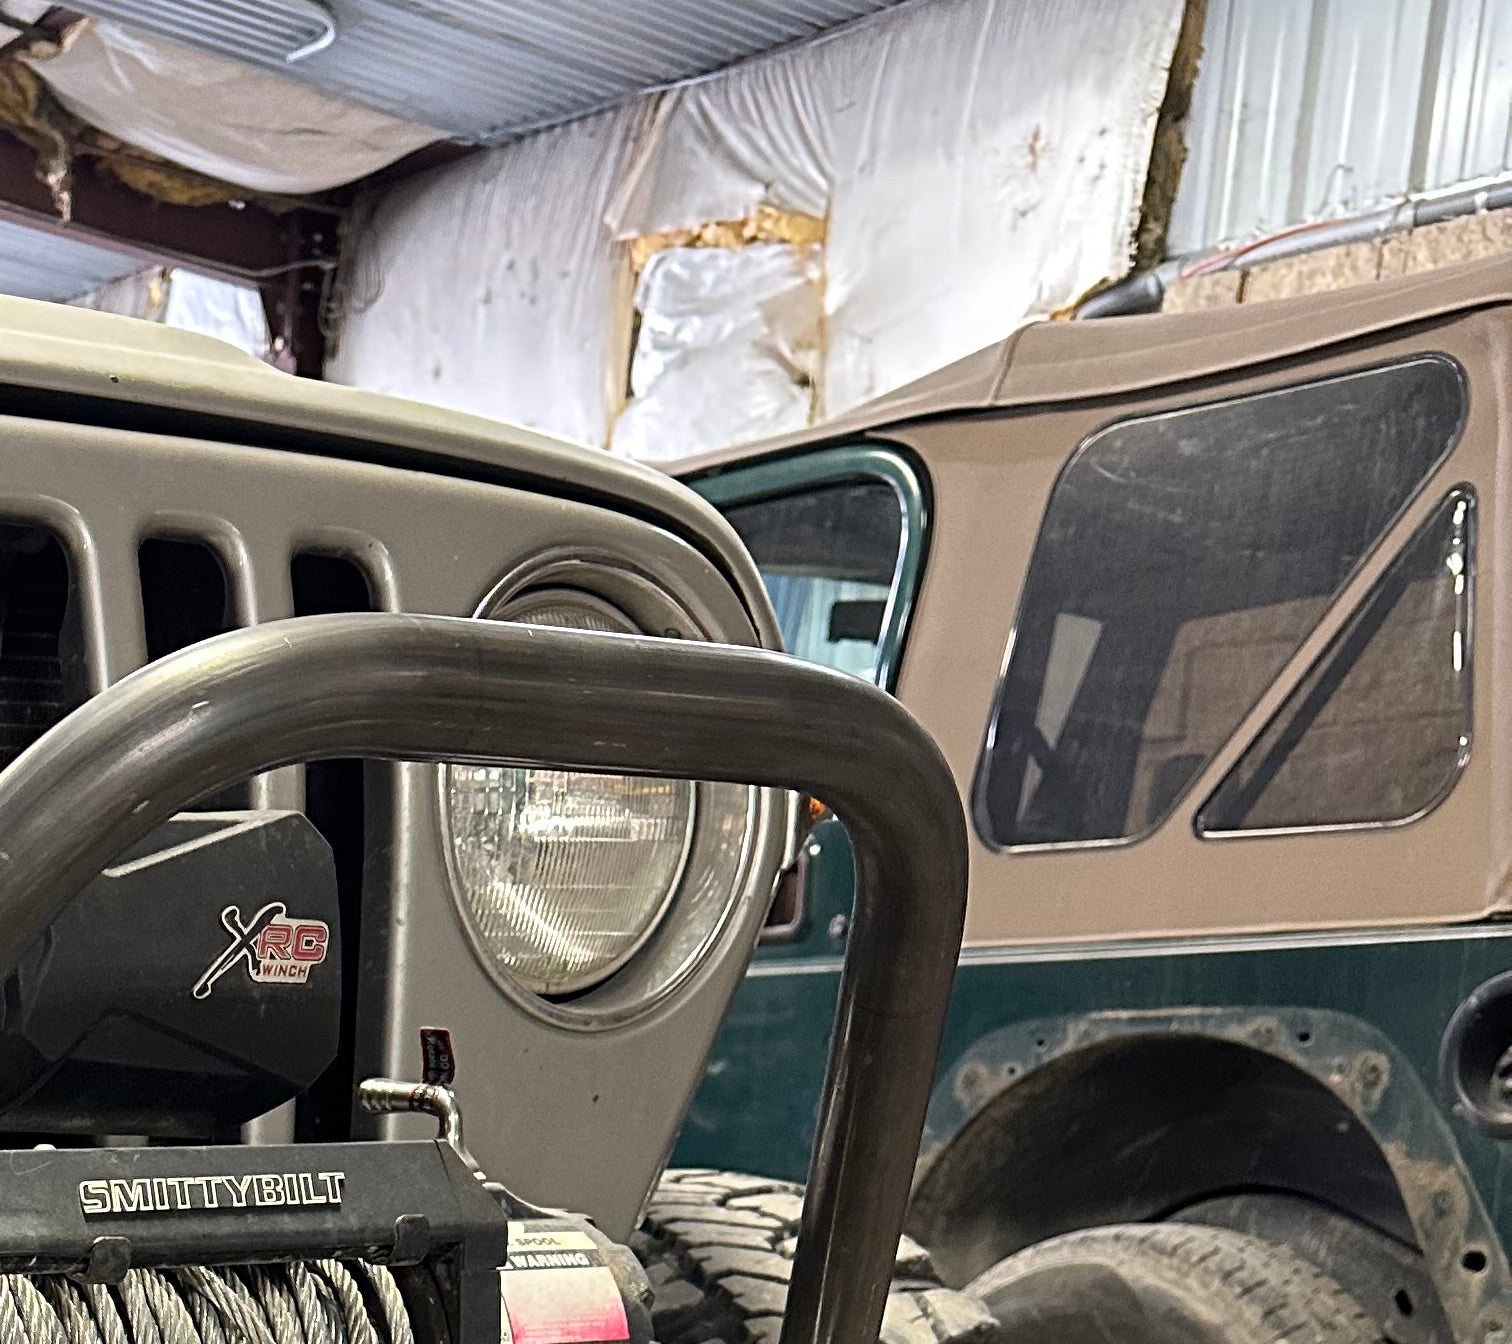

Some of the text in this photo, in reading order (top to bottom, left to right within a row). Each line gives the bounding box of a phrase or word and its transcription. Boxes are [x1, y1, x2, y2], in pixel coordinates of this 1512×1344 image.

[193, 902, 330, 999] XRC
[262, 963, 308, 979] WINCH
[79, 1172, 345, 1214] SMITTYBILT
[514, 1237, 563, 1246] SPOOL
[510, 1252, 590, 1268] WARNING
